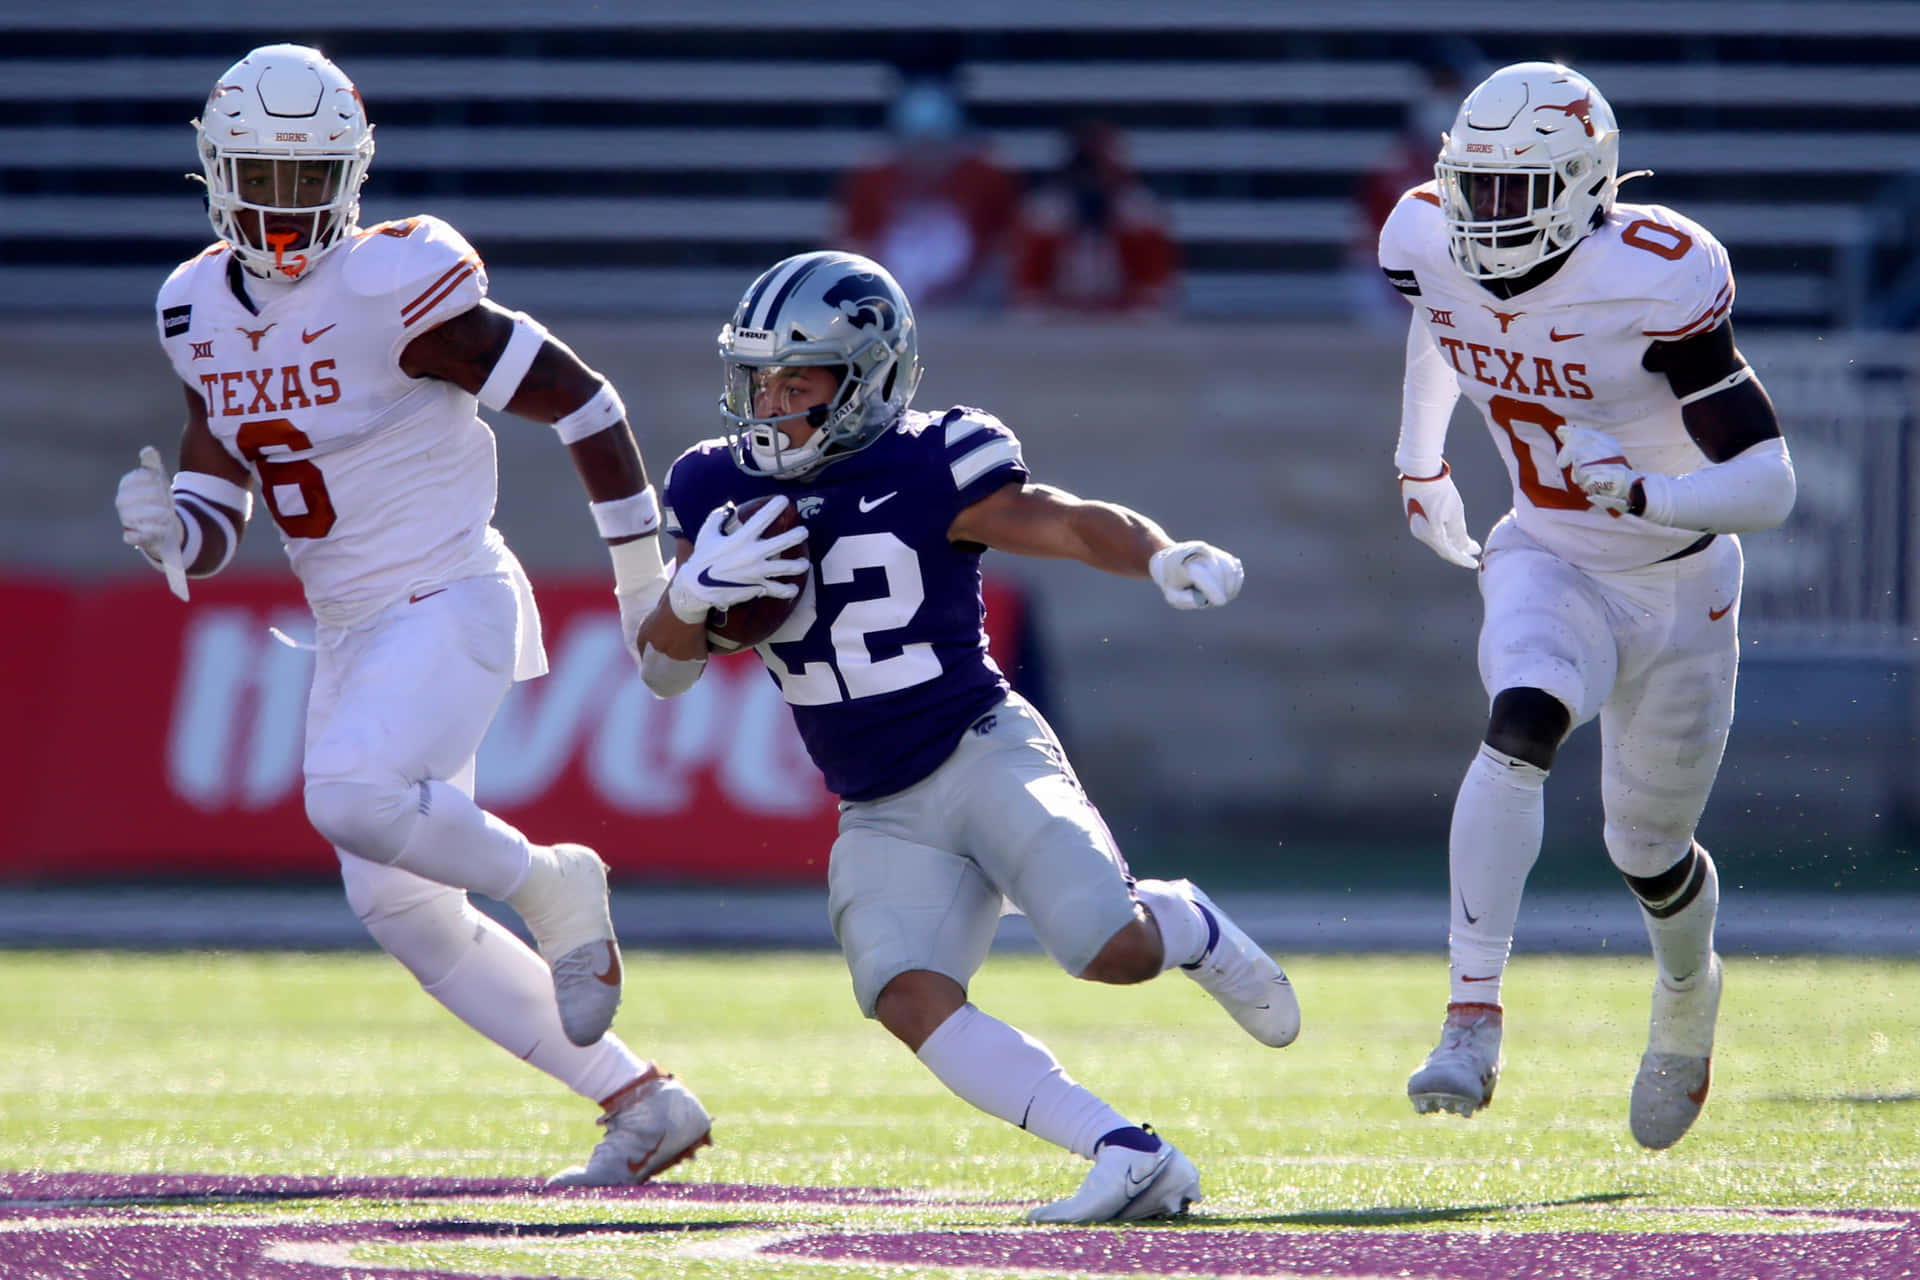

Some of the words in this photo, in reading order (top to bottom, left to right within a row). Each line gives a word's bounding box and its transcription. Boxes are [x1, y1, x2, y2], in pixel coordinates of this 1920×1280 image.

[1621, 220, 1693, 260] 0
[200, 359, 341, 417] TEXAS
[1439, 336, 1594, 400] TEXAS
[236, 418, 337, 539] 6
[1488, 395, 1599, 511] 0
[754, 532, 943, 706] 22
